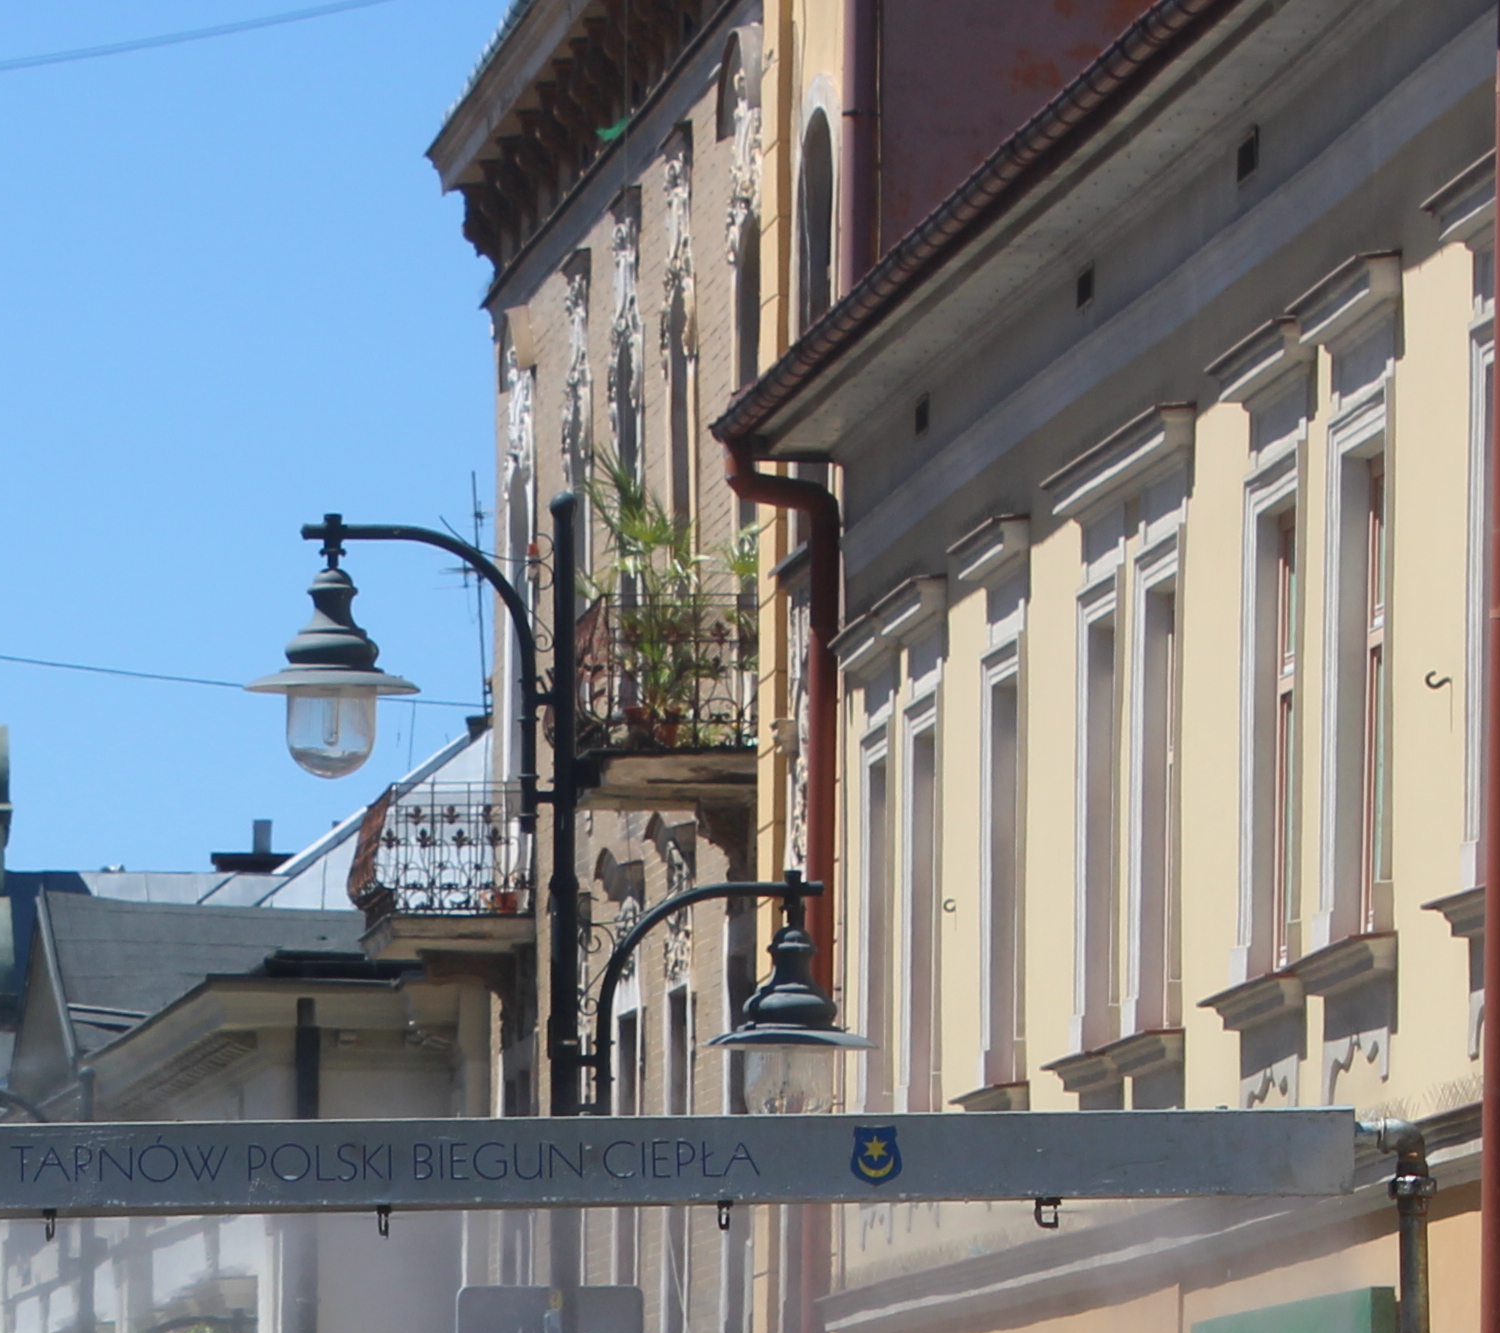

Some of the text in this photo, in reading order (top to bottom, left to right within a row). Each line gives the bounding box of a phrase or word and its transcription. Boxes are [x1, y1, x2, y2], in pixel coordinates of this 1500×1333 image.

[10, 1135, 762, 1184] TARNÓW POLSKI BIEGUN CIEPŁA
